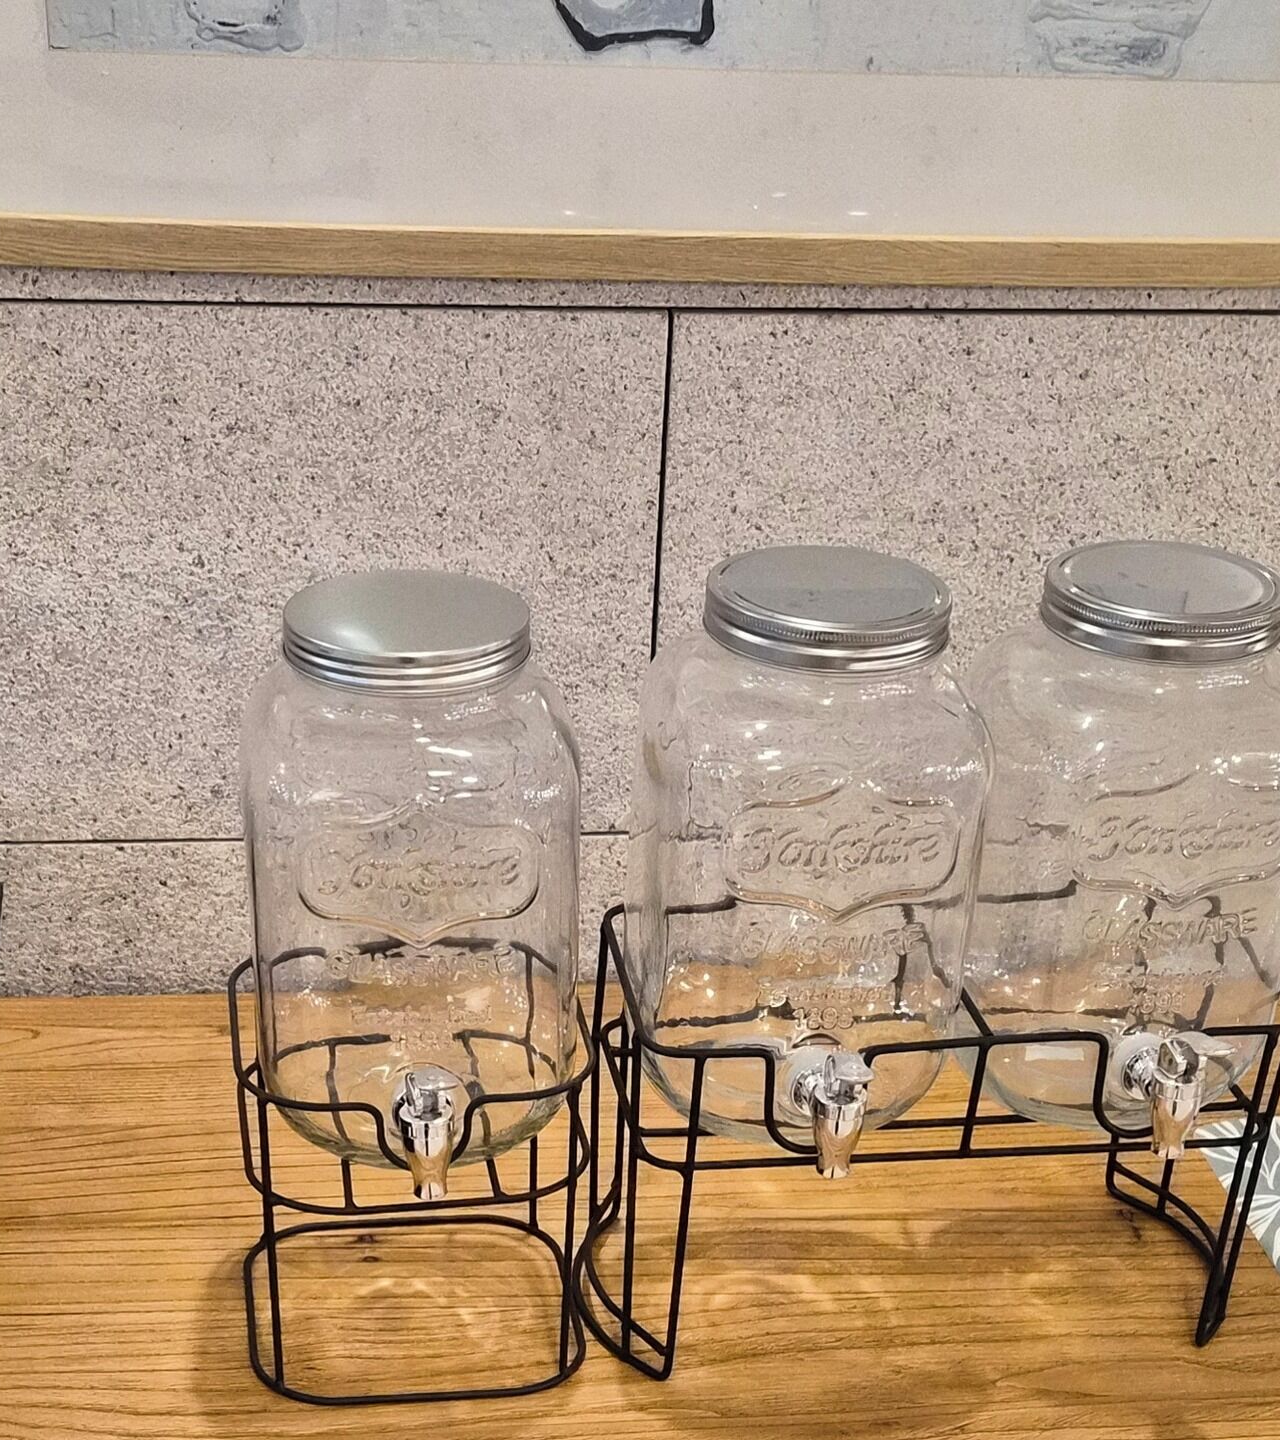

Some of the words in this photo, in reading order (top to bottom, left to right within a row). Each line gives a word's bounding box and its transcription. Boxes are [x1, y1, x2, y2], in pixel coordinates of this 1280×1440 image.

[739, 820, 942, 875] Yorkshire
[740, 924, 926, 964] GLASSWARE
[1082, 907, 1257, 948] GLASSWARE
[326, 942, 515, 986] GLASSWARE
